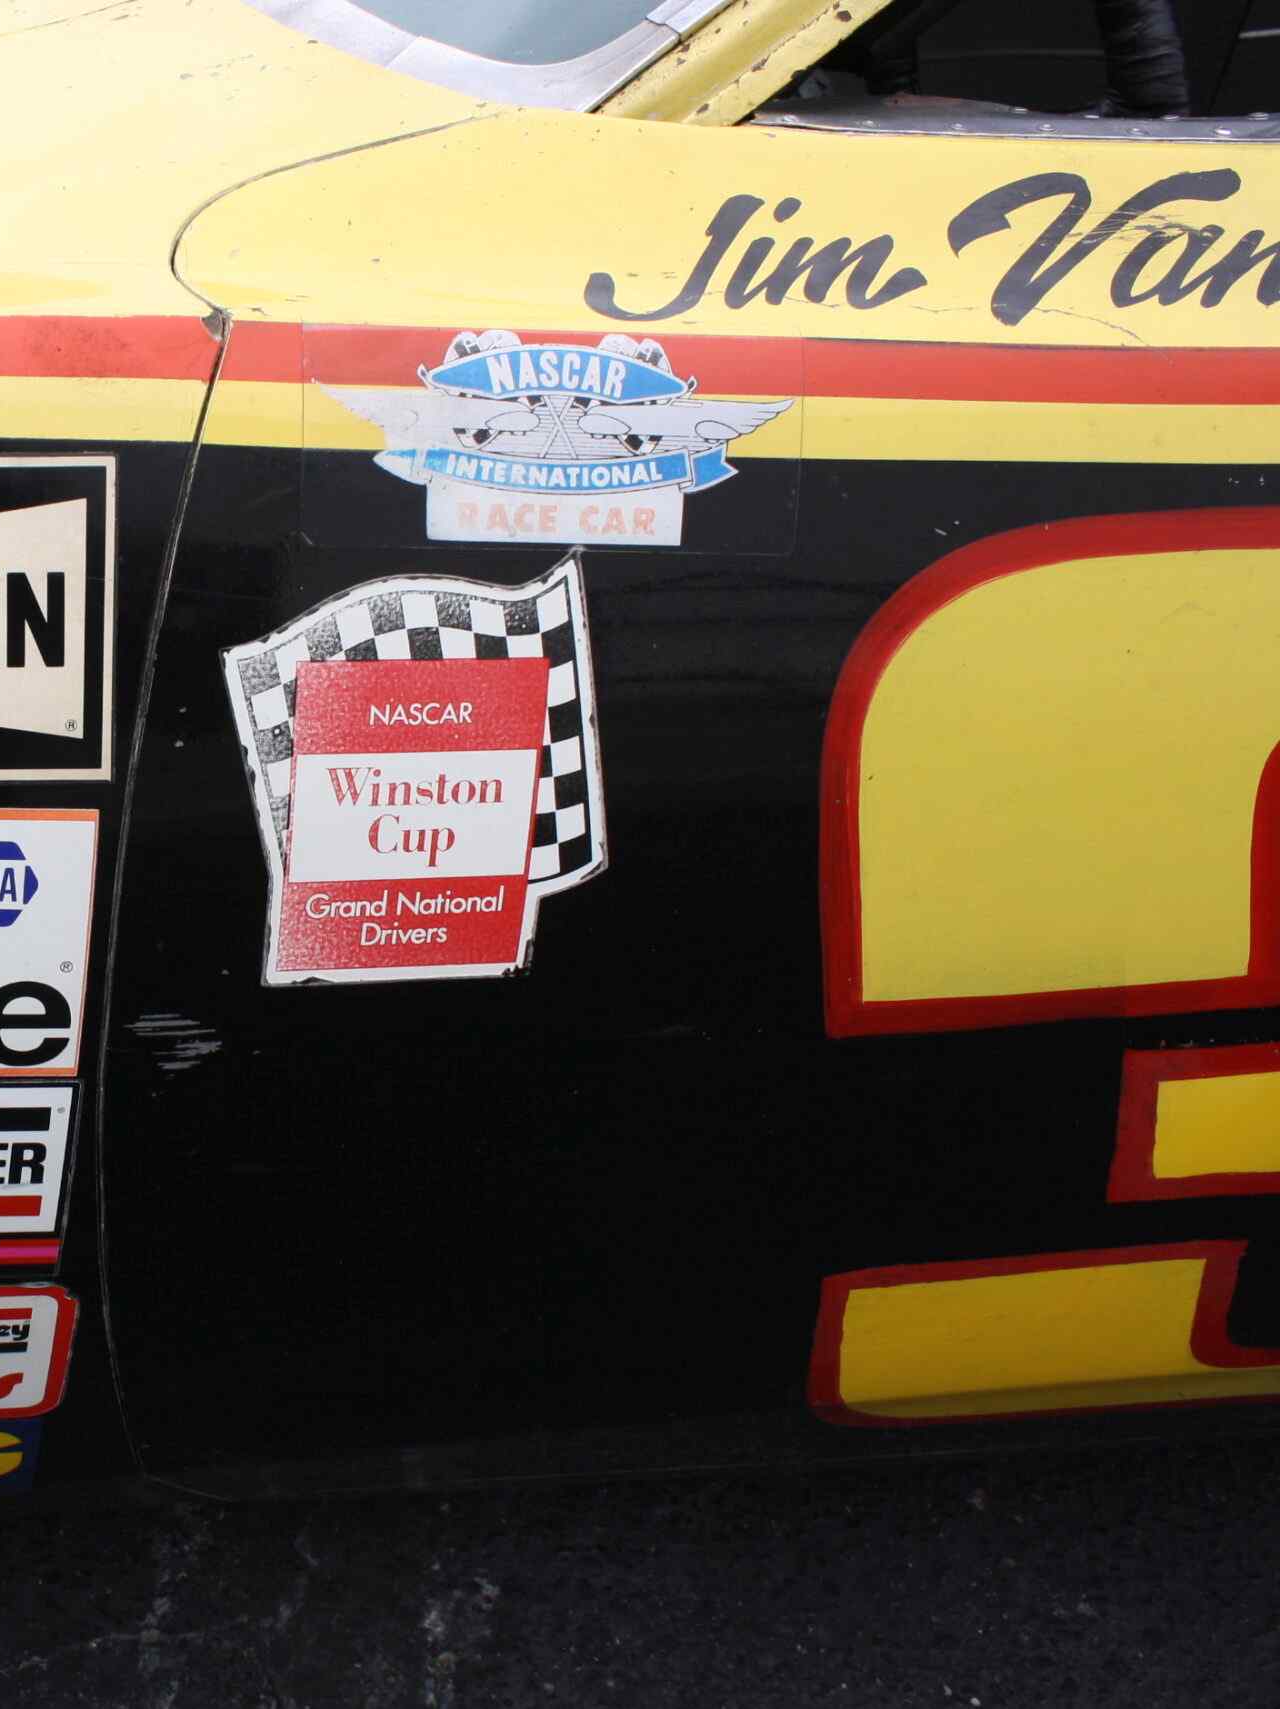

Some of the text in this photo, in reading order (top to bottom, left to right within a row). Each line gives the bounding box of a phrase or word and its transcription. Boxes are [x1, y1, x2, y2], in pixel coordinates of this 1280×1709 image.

[584, 194, 927, 321] Jim
[486, 351, 629, 397] NASCAR
[445, 453, 663, 488] INTERNATIONAL
[456, 503, 656, 536] RACE CAR
[368, 702, 473, 726] NASCAR
[326, 767, 505, 807] Winston
[368, 814, 456, 867] Cup
[305, 885, 504, 917] Grand National
[360, 922, 447, 946] Drivers
